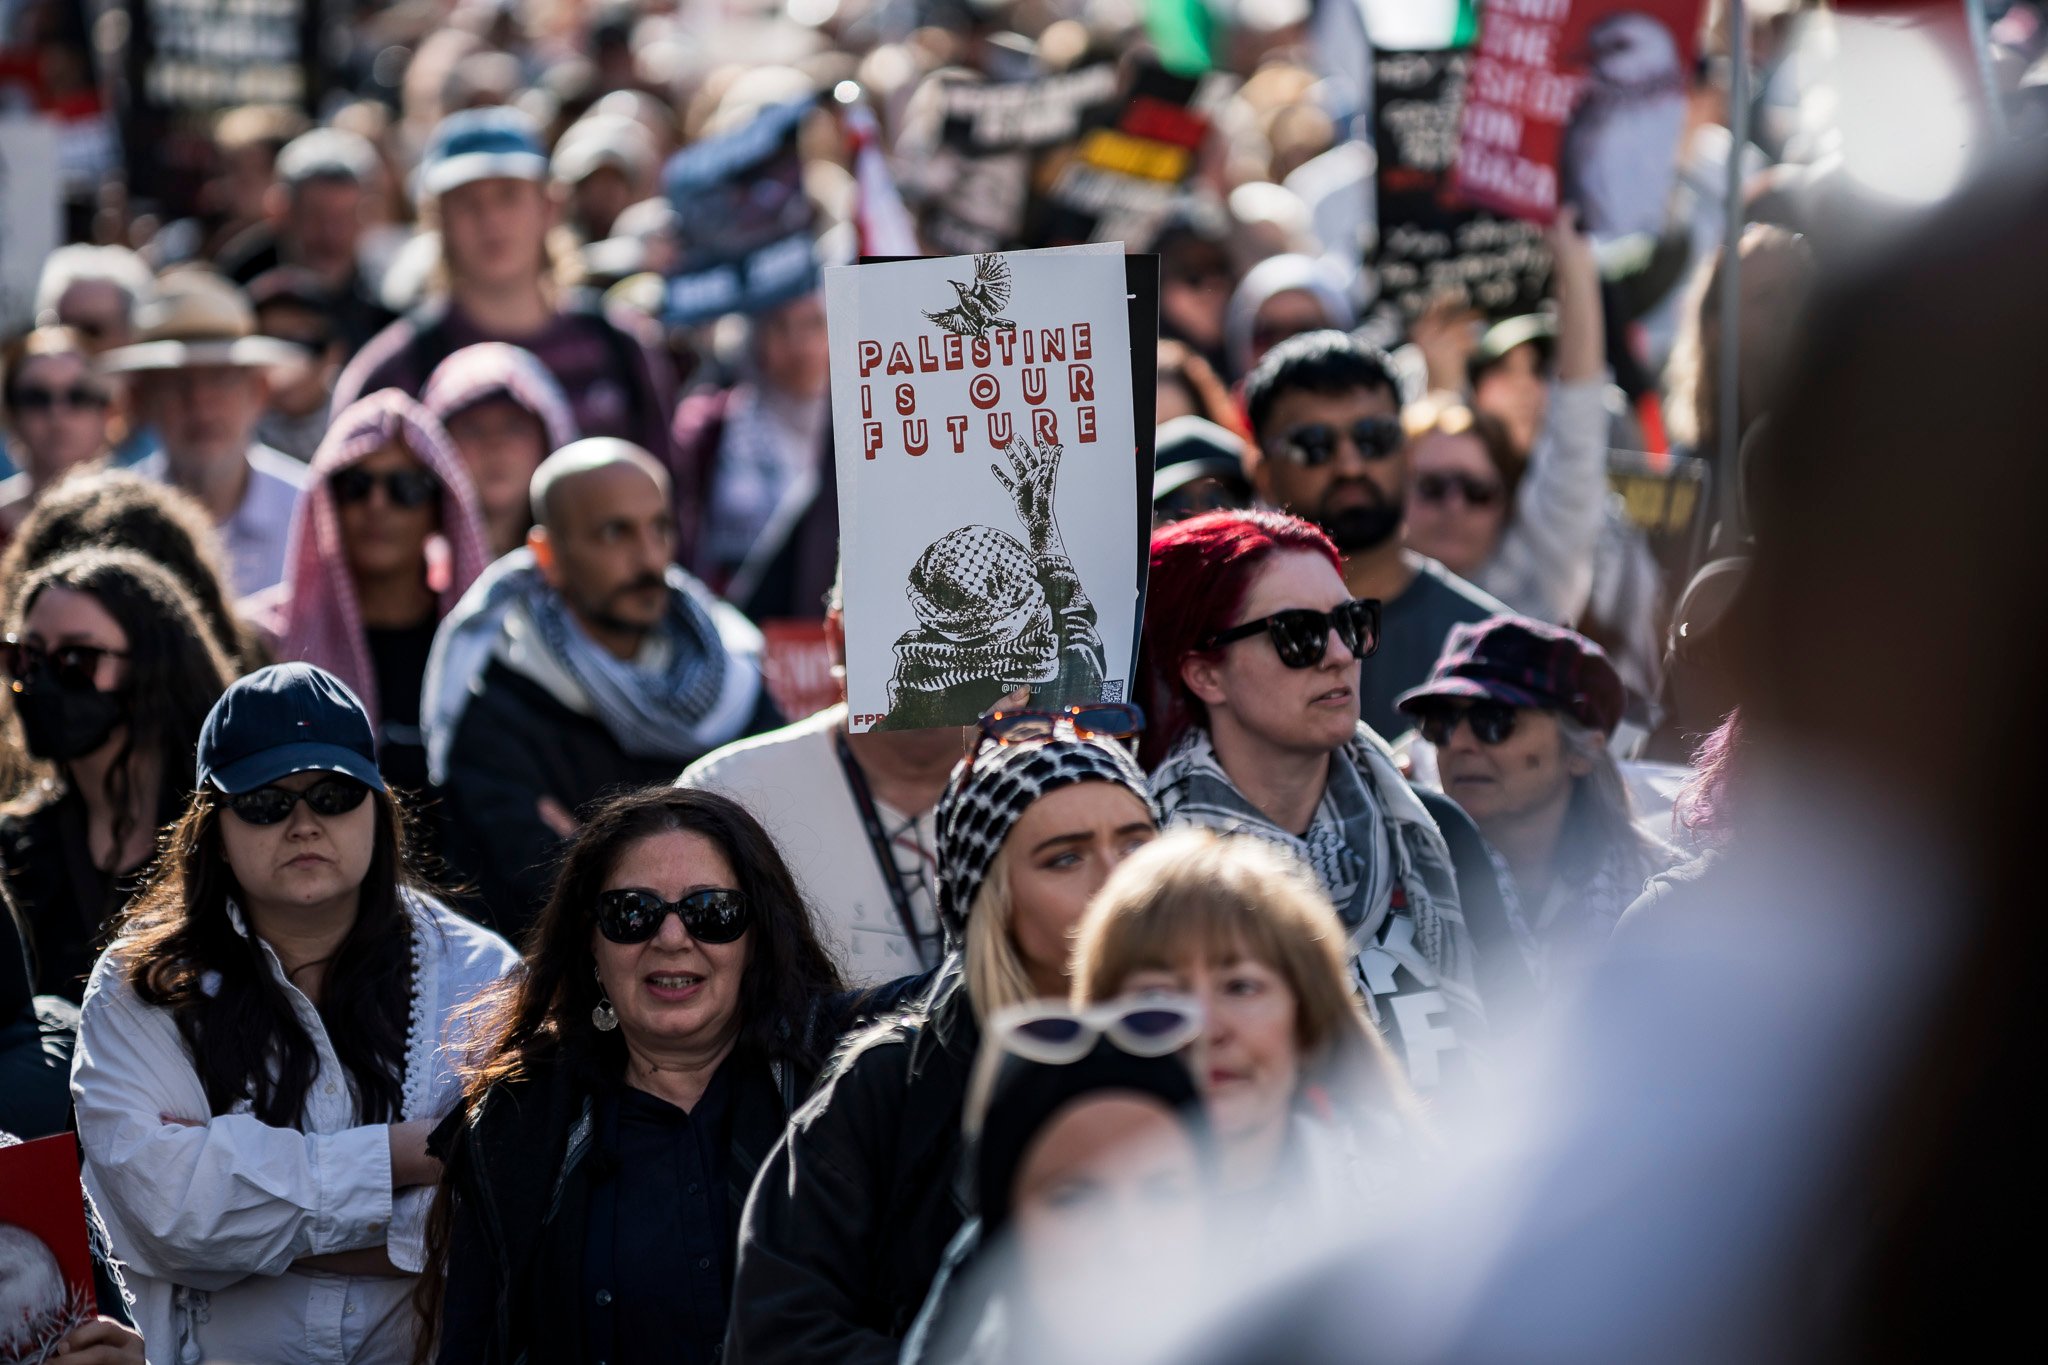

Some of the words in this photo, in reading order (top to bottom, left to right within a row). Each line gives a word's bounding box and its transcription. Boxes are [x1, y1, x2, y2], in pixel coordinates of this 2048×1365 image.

[858, 322, 1092, 378] PALESTINE
[861, 383, 916, 419] IS
[969, 363, 1095, 410] OUR
[863, 406, 1097, 460] FUTURE
